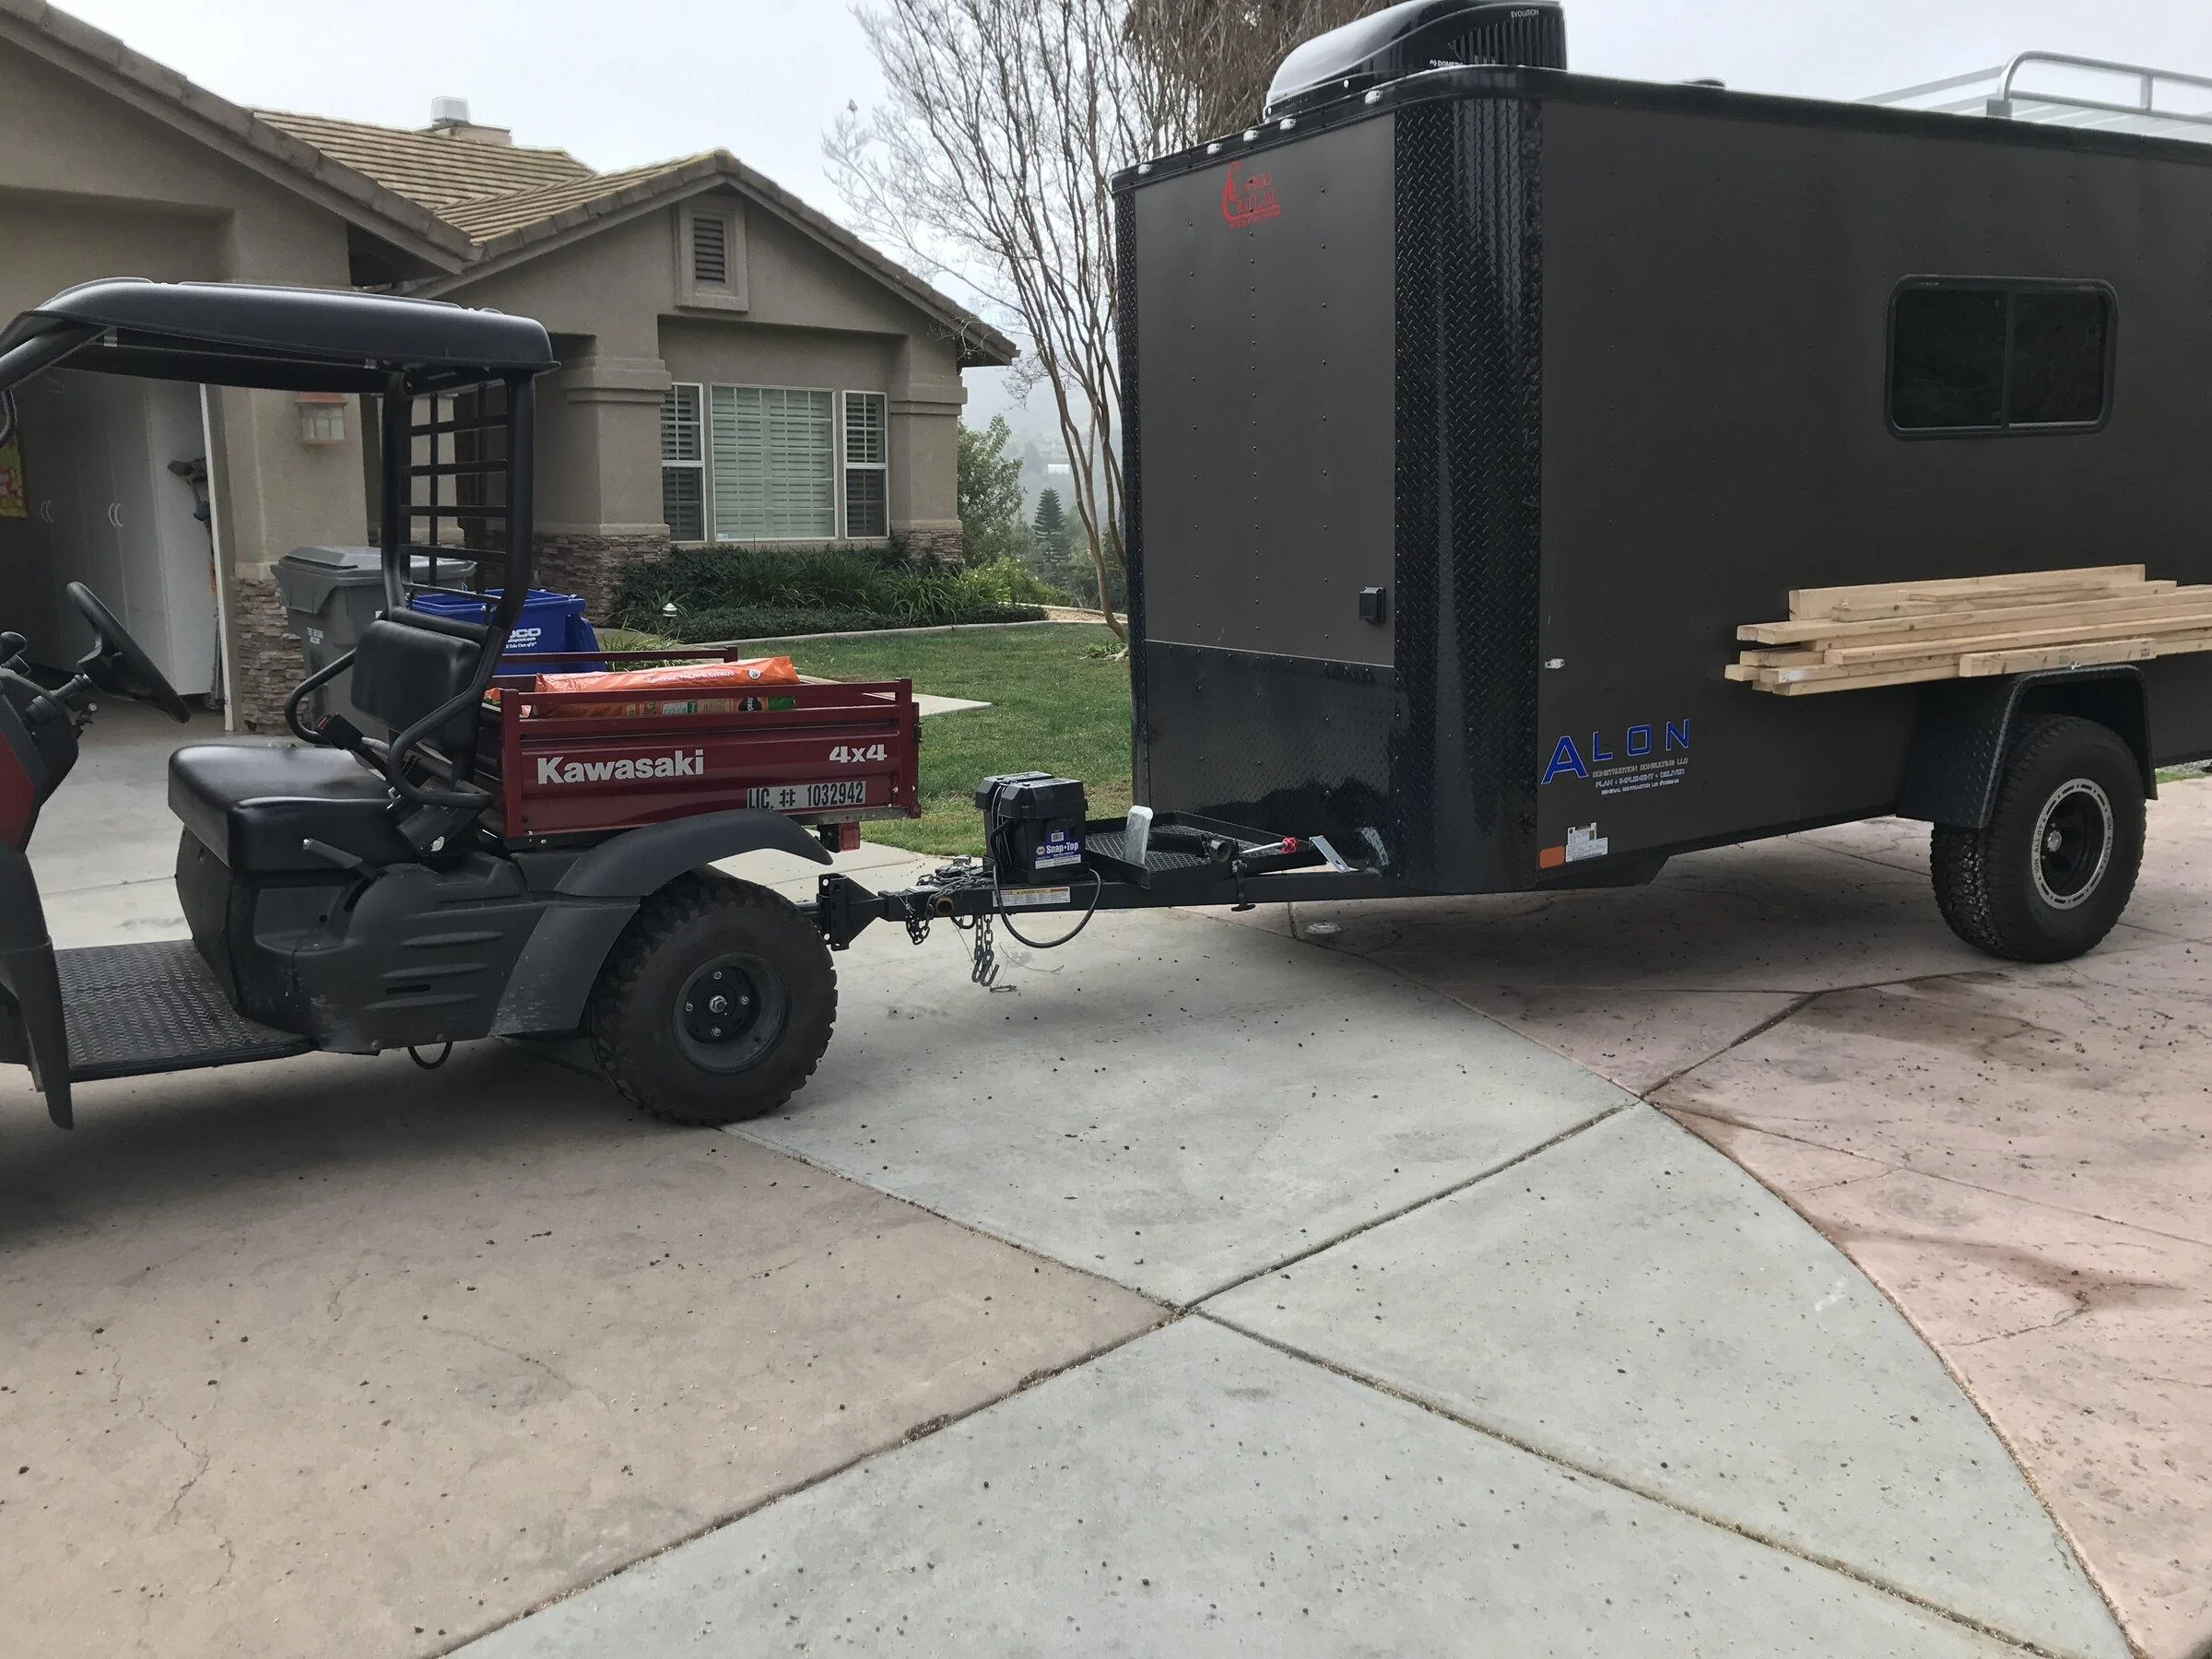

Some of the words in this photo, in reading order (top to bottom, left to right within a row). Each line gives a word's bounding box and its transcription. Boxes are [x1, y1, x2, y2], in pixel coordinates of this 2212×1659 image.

[1511, 8, 1539, 18] EVOLUTION
[830, 744, 888, 763] 4x4
[1541, 719, 1689, 784] ALON
[537, 748, 704, 784] Kawasaki
[748, 788, 774, 809] LIC.
[806, 782, 864, 807] 1032942
